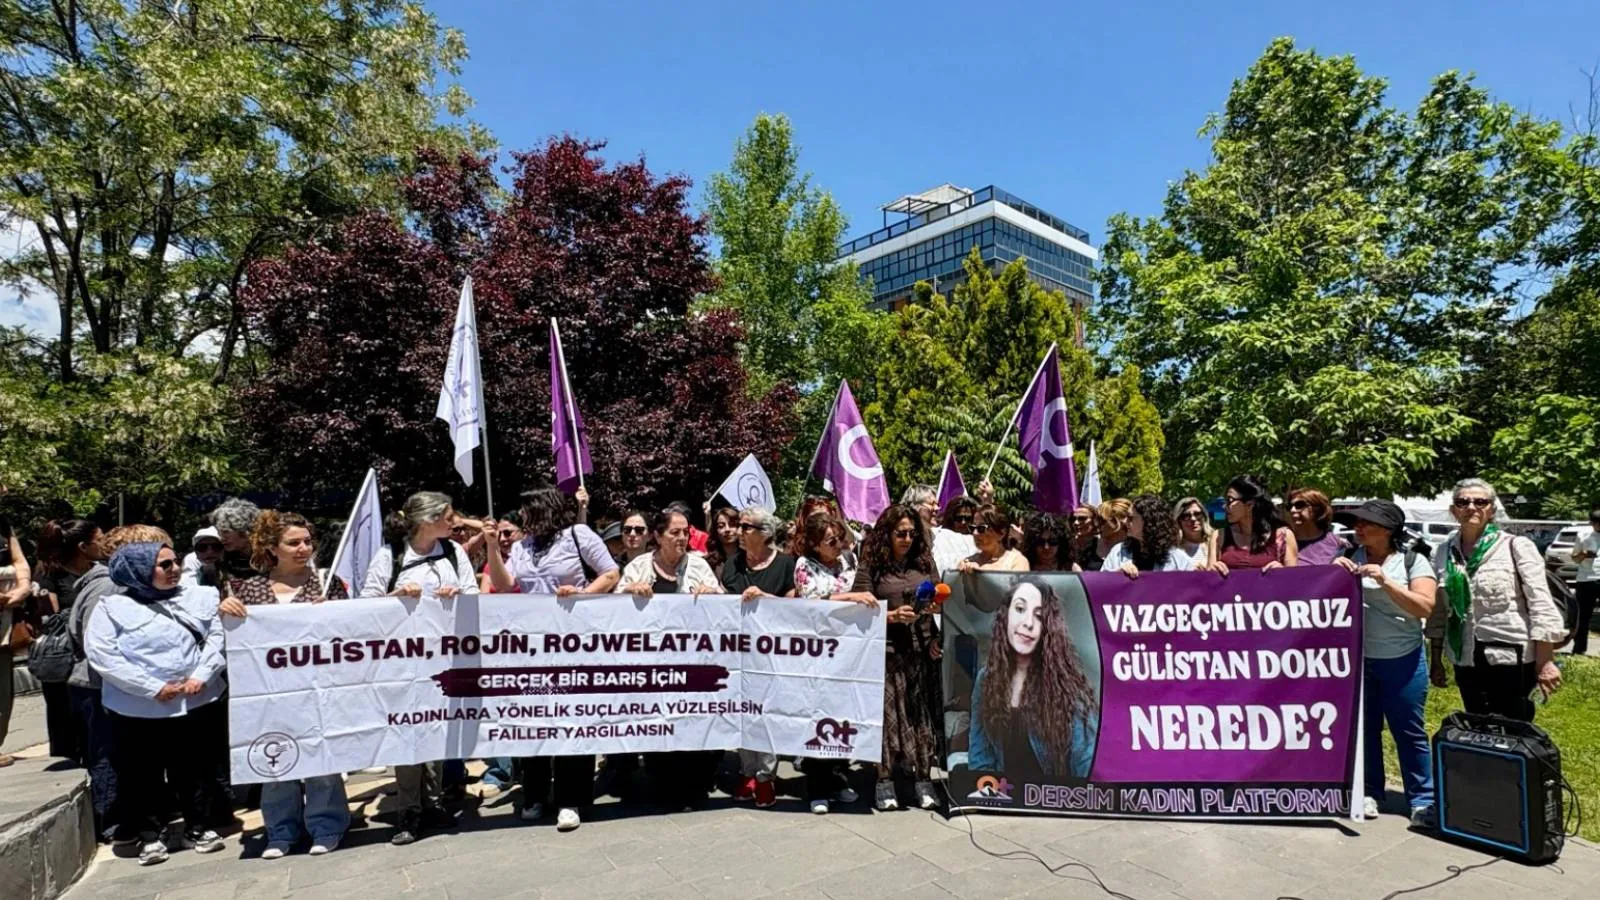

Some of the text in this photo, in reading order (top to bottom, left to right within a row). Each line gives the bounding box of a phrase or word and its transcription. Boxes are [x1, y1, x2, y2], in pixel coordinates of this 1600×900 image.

[1102, 594, 1352, 640] VAZGEÇMİYORUZ
[266, 629, 839, 669] GULÎSTAN, ROJÎN, ROJWELAT'A NE OLDU?
[1112, 643, 1351, 681] GÜLİSTAN DOKU
[477, 668, 687, 690] GERÇEK BİR BARIŞ İÇİN
[388, 700, 763, 726] KADINLARA YÖNELİK SUÇLARLA YÜZLEŞİLSİN
[1129, 702, 1339, 751] NEREDE?
[488, 723, 675, 742] FAİLLER YARGILANSIN
[1024, 782, 1352, 814] DERSİM KADIN PLATFORMU
